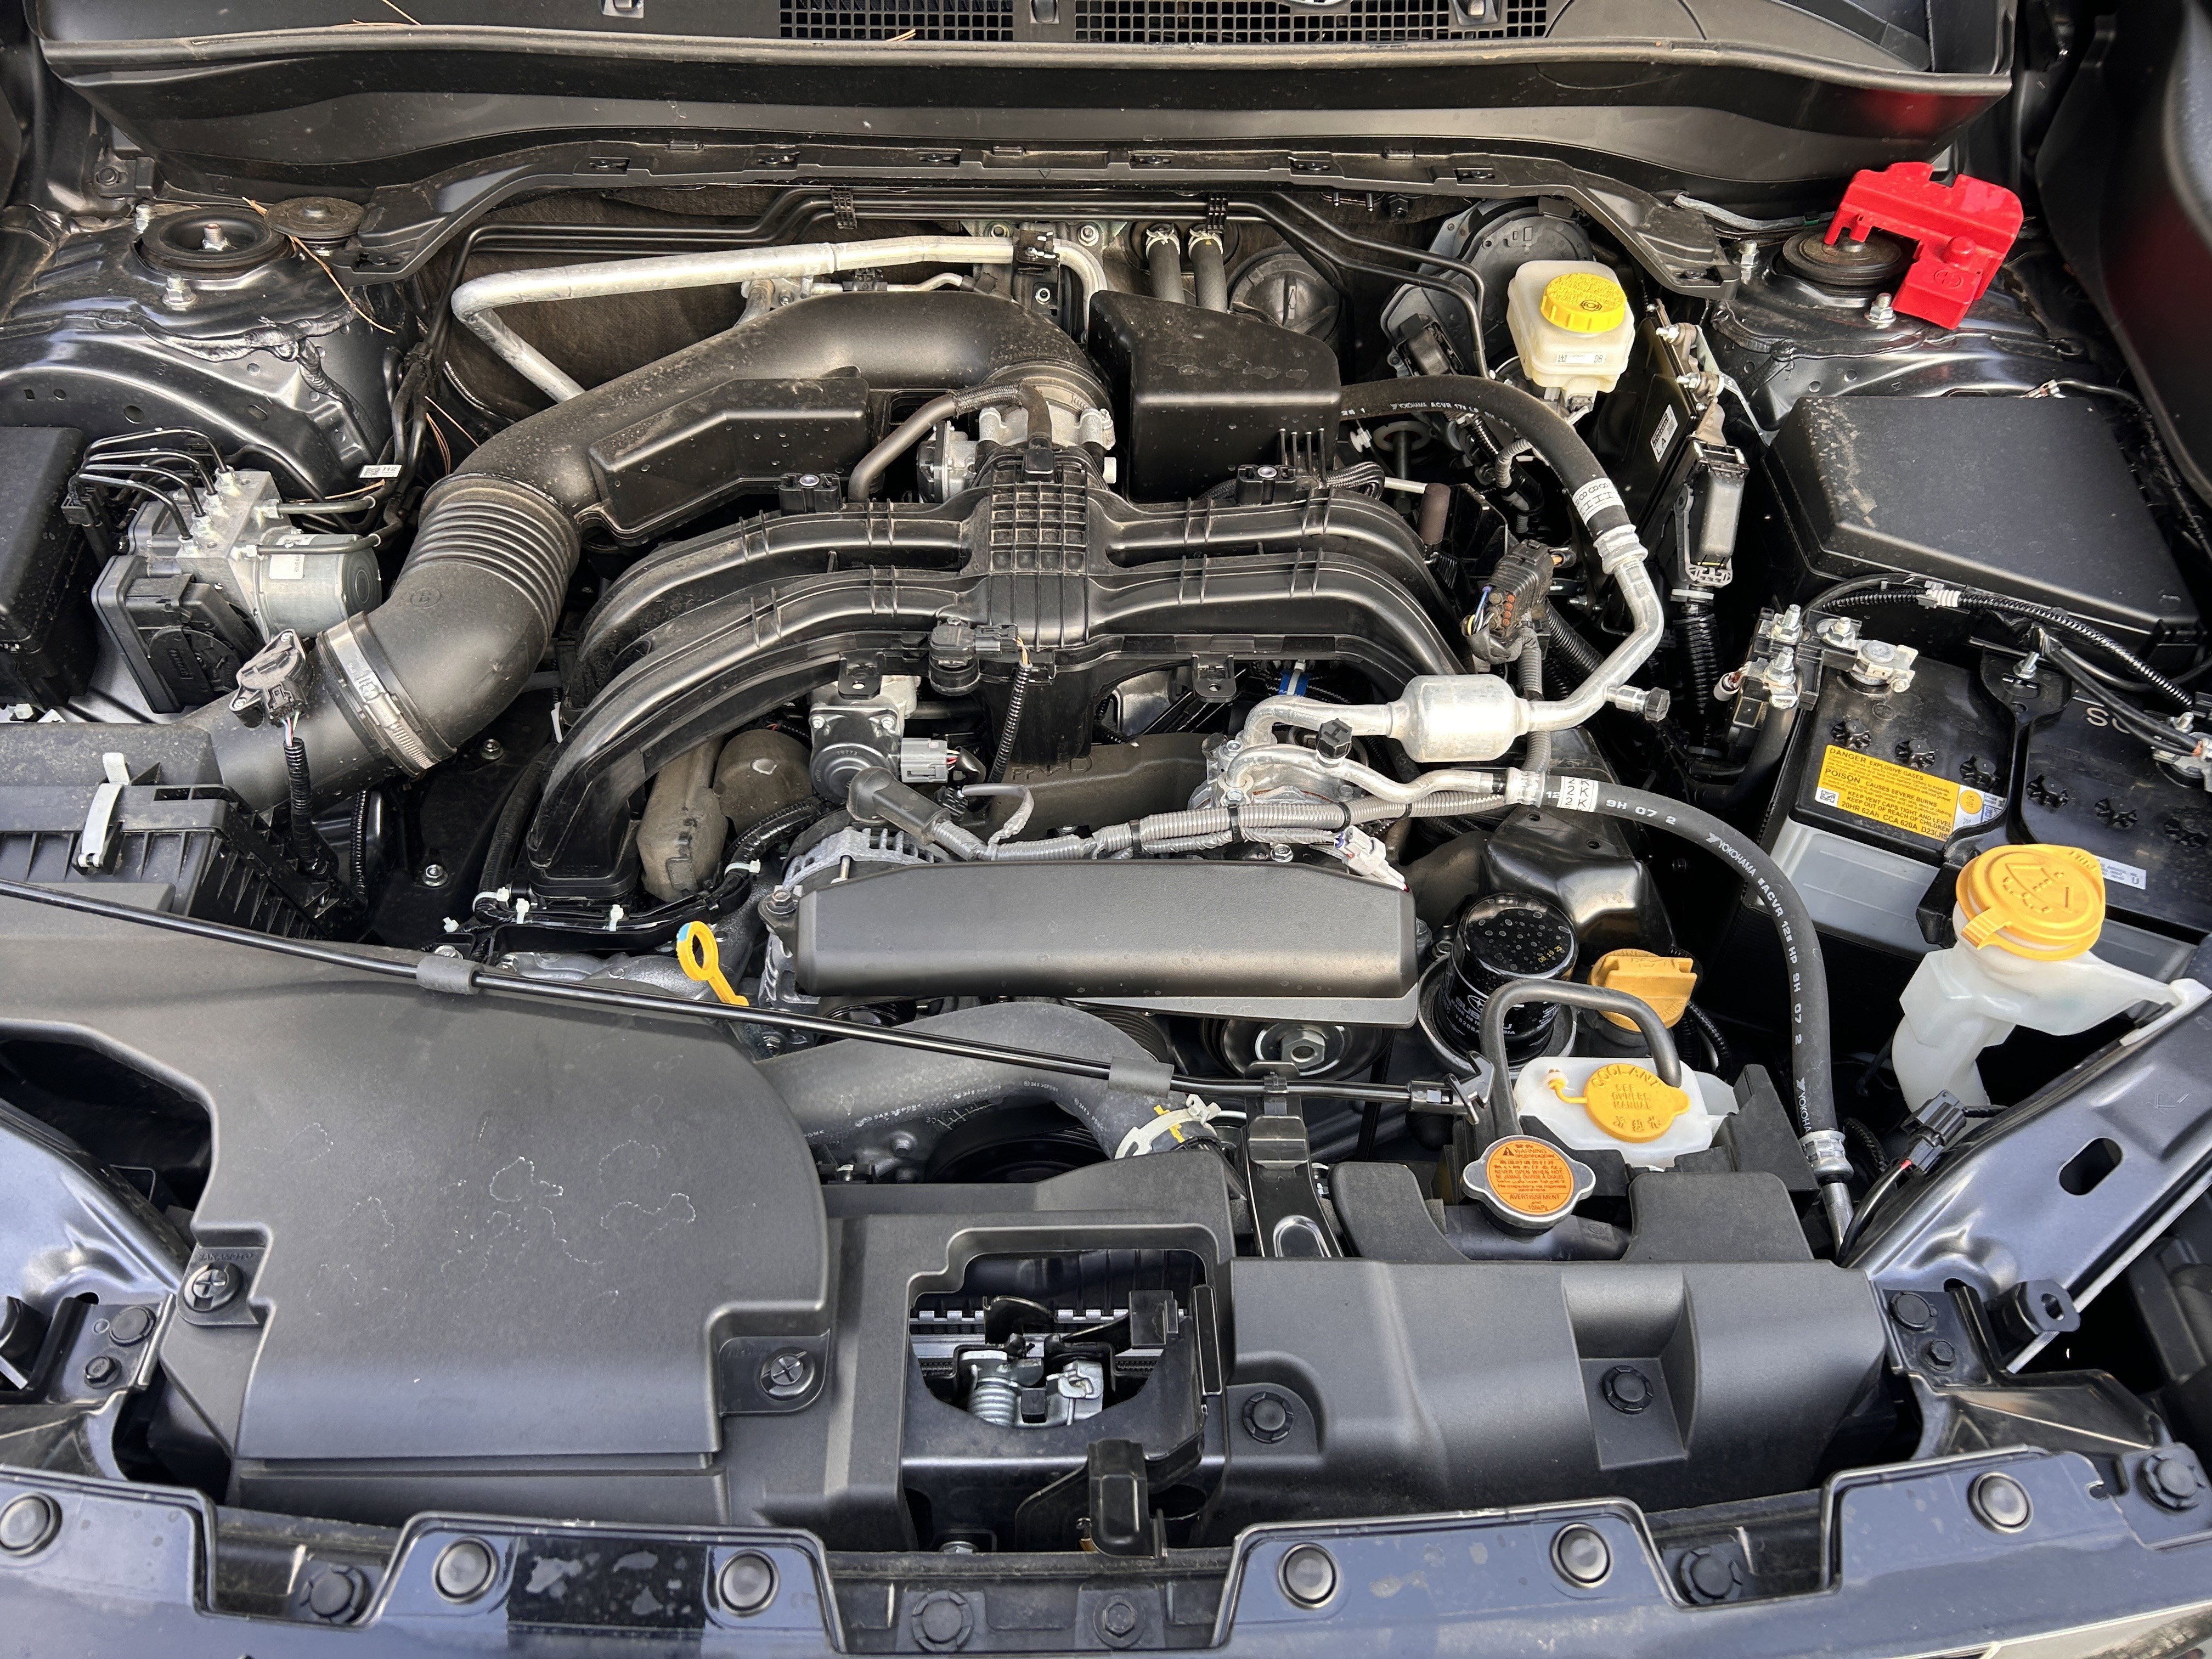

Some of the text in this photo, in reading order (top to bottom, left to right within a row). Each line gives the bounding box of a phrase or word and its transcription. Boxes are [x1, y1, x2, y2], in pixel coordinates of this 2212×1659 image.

[1830, 747, 1923, 781] DANGER EXPLOSIVE GASES
[1566, 786, 1589, 797] 2 K
[1825, 767, 1937, 808] POISON CAUSES SEVERE BURNS
[1565, 798, 1586, 808] 2 K
[1605, 799, 1628, 810] 9H
[1635, 806, 1657, 818] 07
[1665, 815, 1677, 825] 2
[1846, 795, 1863, 805] KEEP
[1863, 800, 1876, 809] OUT
[1887, 808, 1909, 819] REACH
[1918, 818, 1950, 833] CHILDREN
[1847, 790, 1953, 828] KEEP VENT CAPS TIGHT AND LEVEL
[1841, 800, 1860, 812] 20HR
[1861, 806, 1880, 818] 62Ah
[1882, 813, 1899, 825] CCA
[1899, 819, 1918, 831] 620A
[1718, 839, 1757, 877] YOKOHAMA
[1760, 884, 1784, 917] ACVR
[1788, 946, 1798, 964] HP
[1792, 972, 1801, 992] 9H
[1794, 1003, 1802, 1024] 07
[1795, 1034, 1802, 1046] 2
[1592, 1065, 1661, 1088] COOLANT
[1615, 1084, 1636, 1092] SEE
[1613, 1101, 1651, 1110] MANUAL
[1798, 1092, 1812, 1133] YOKOHA
